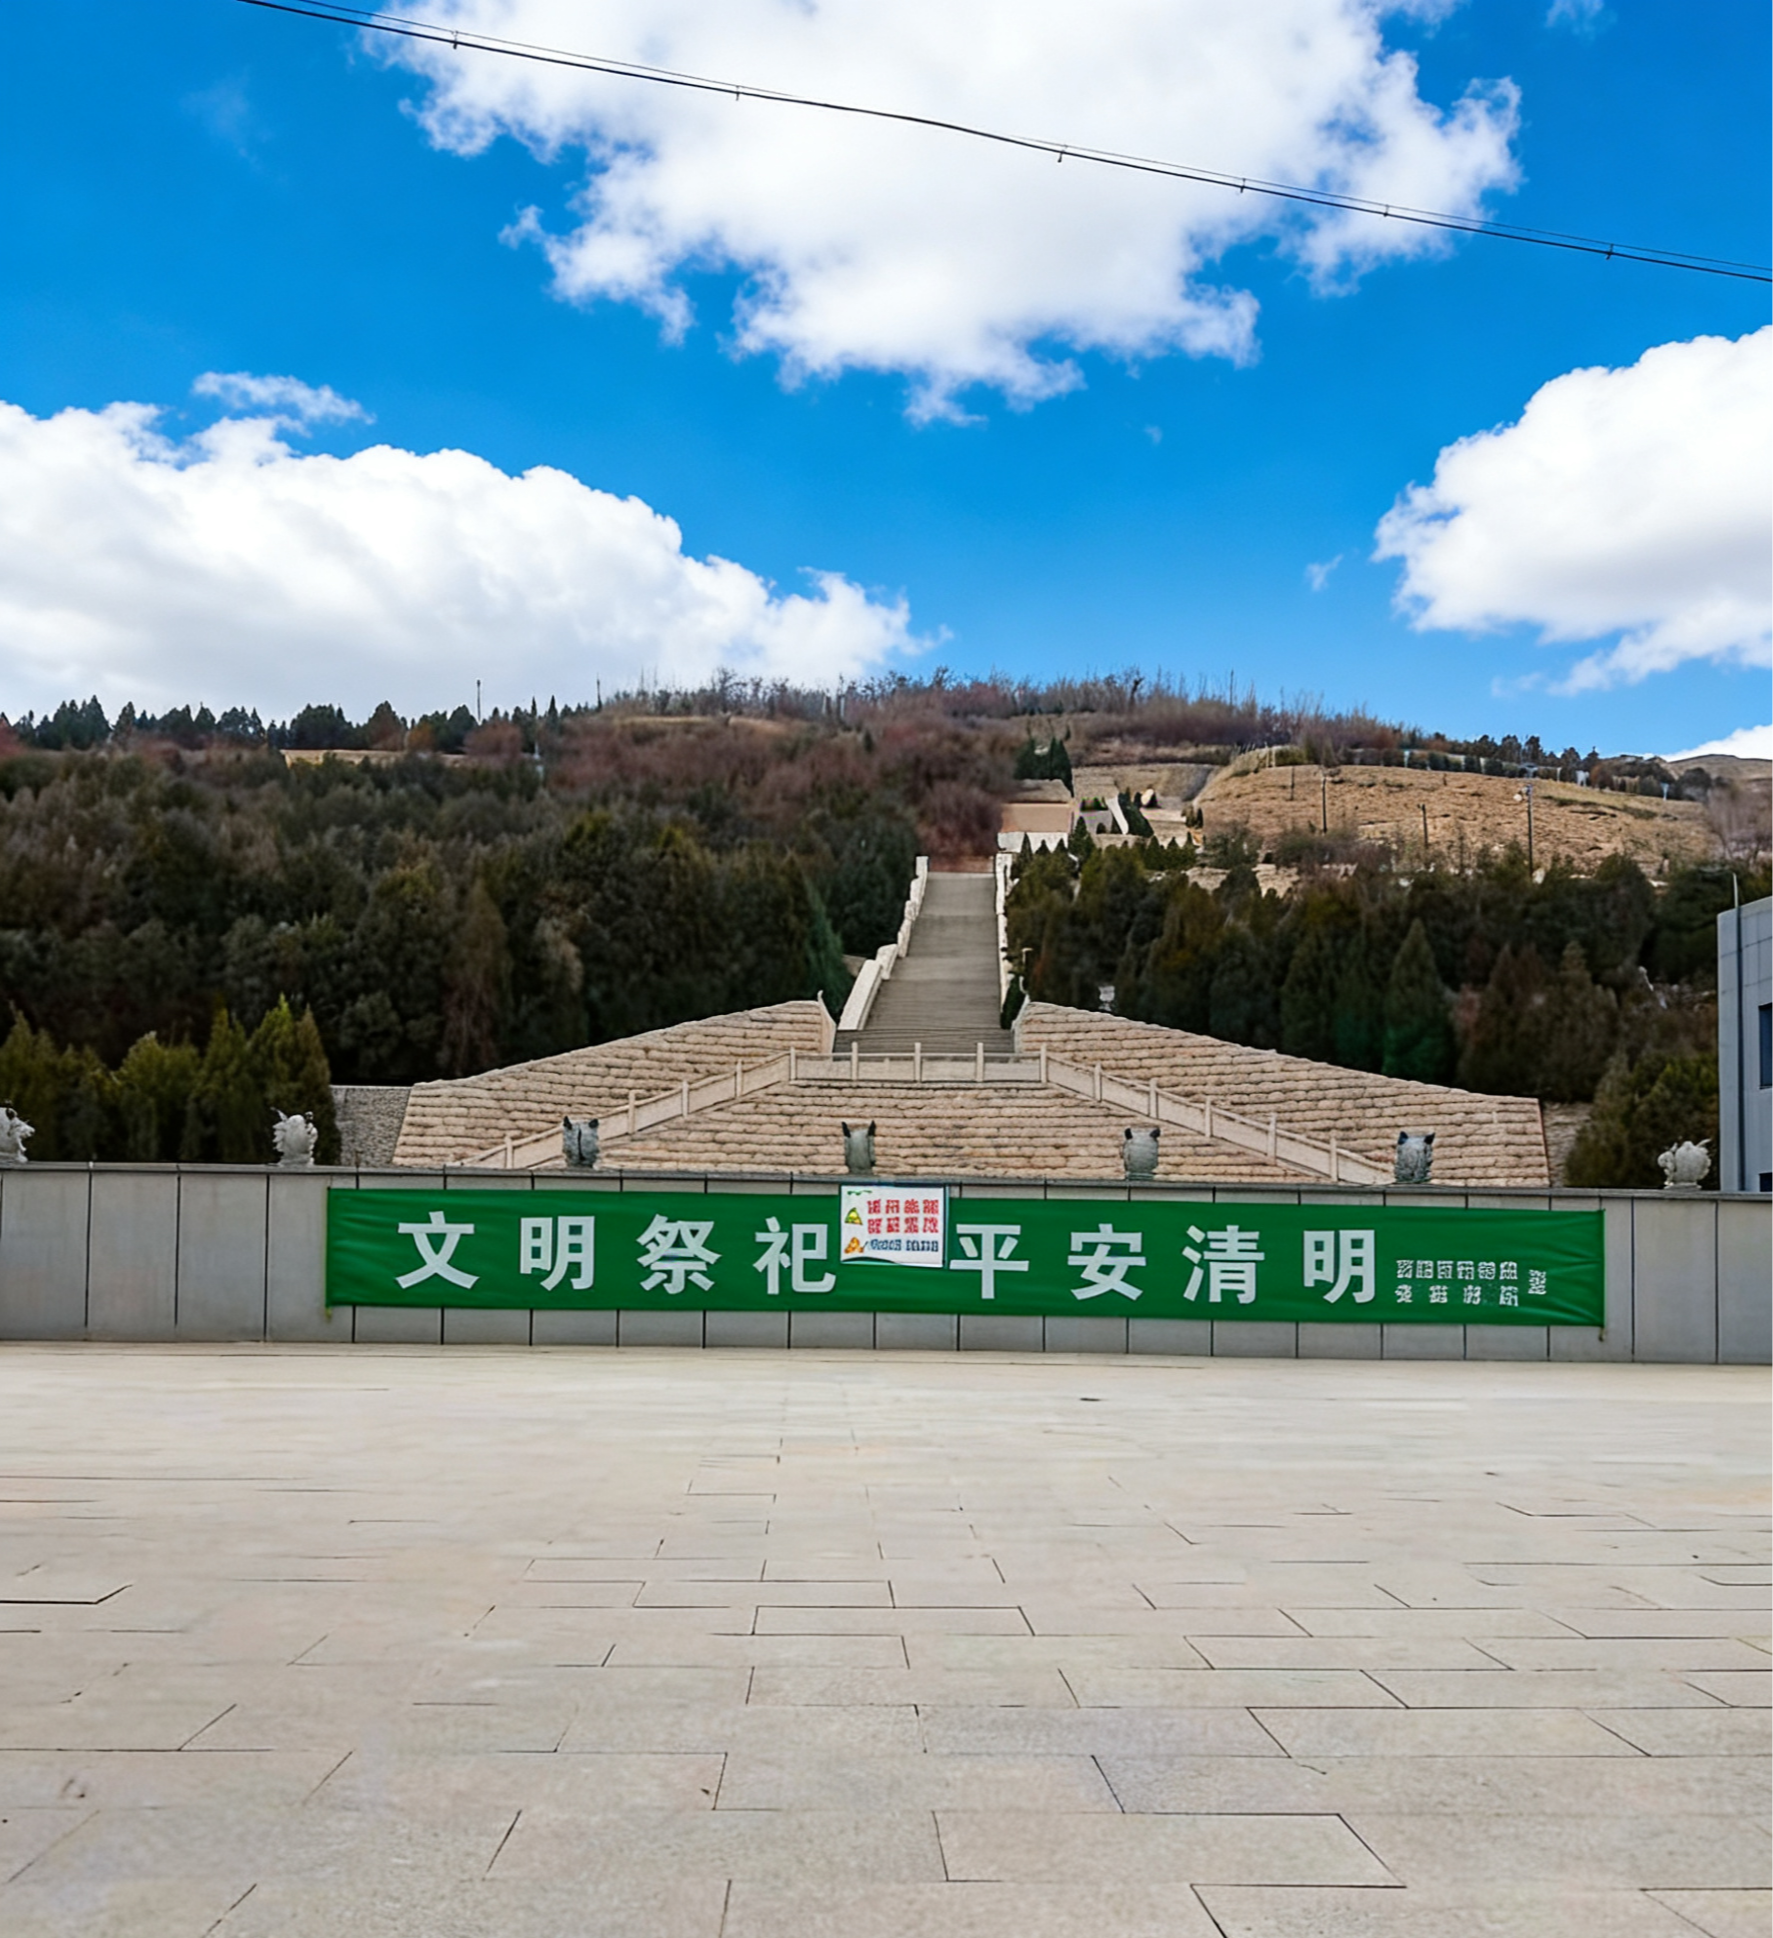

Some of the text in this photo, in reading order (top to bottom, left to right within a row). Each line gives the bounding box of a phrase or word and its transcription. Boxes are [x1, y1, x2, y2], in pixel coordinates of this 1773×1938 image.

[396, 1210, 1376, 1304] 文明祭祀 平安清明
